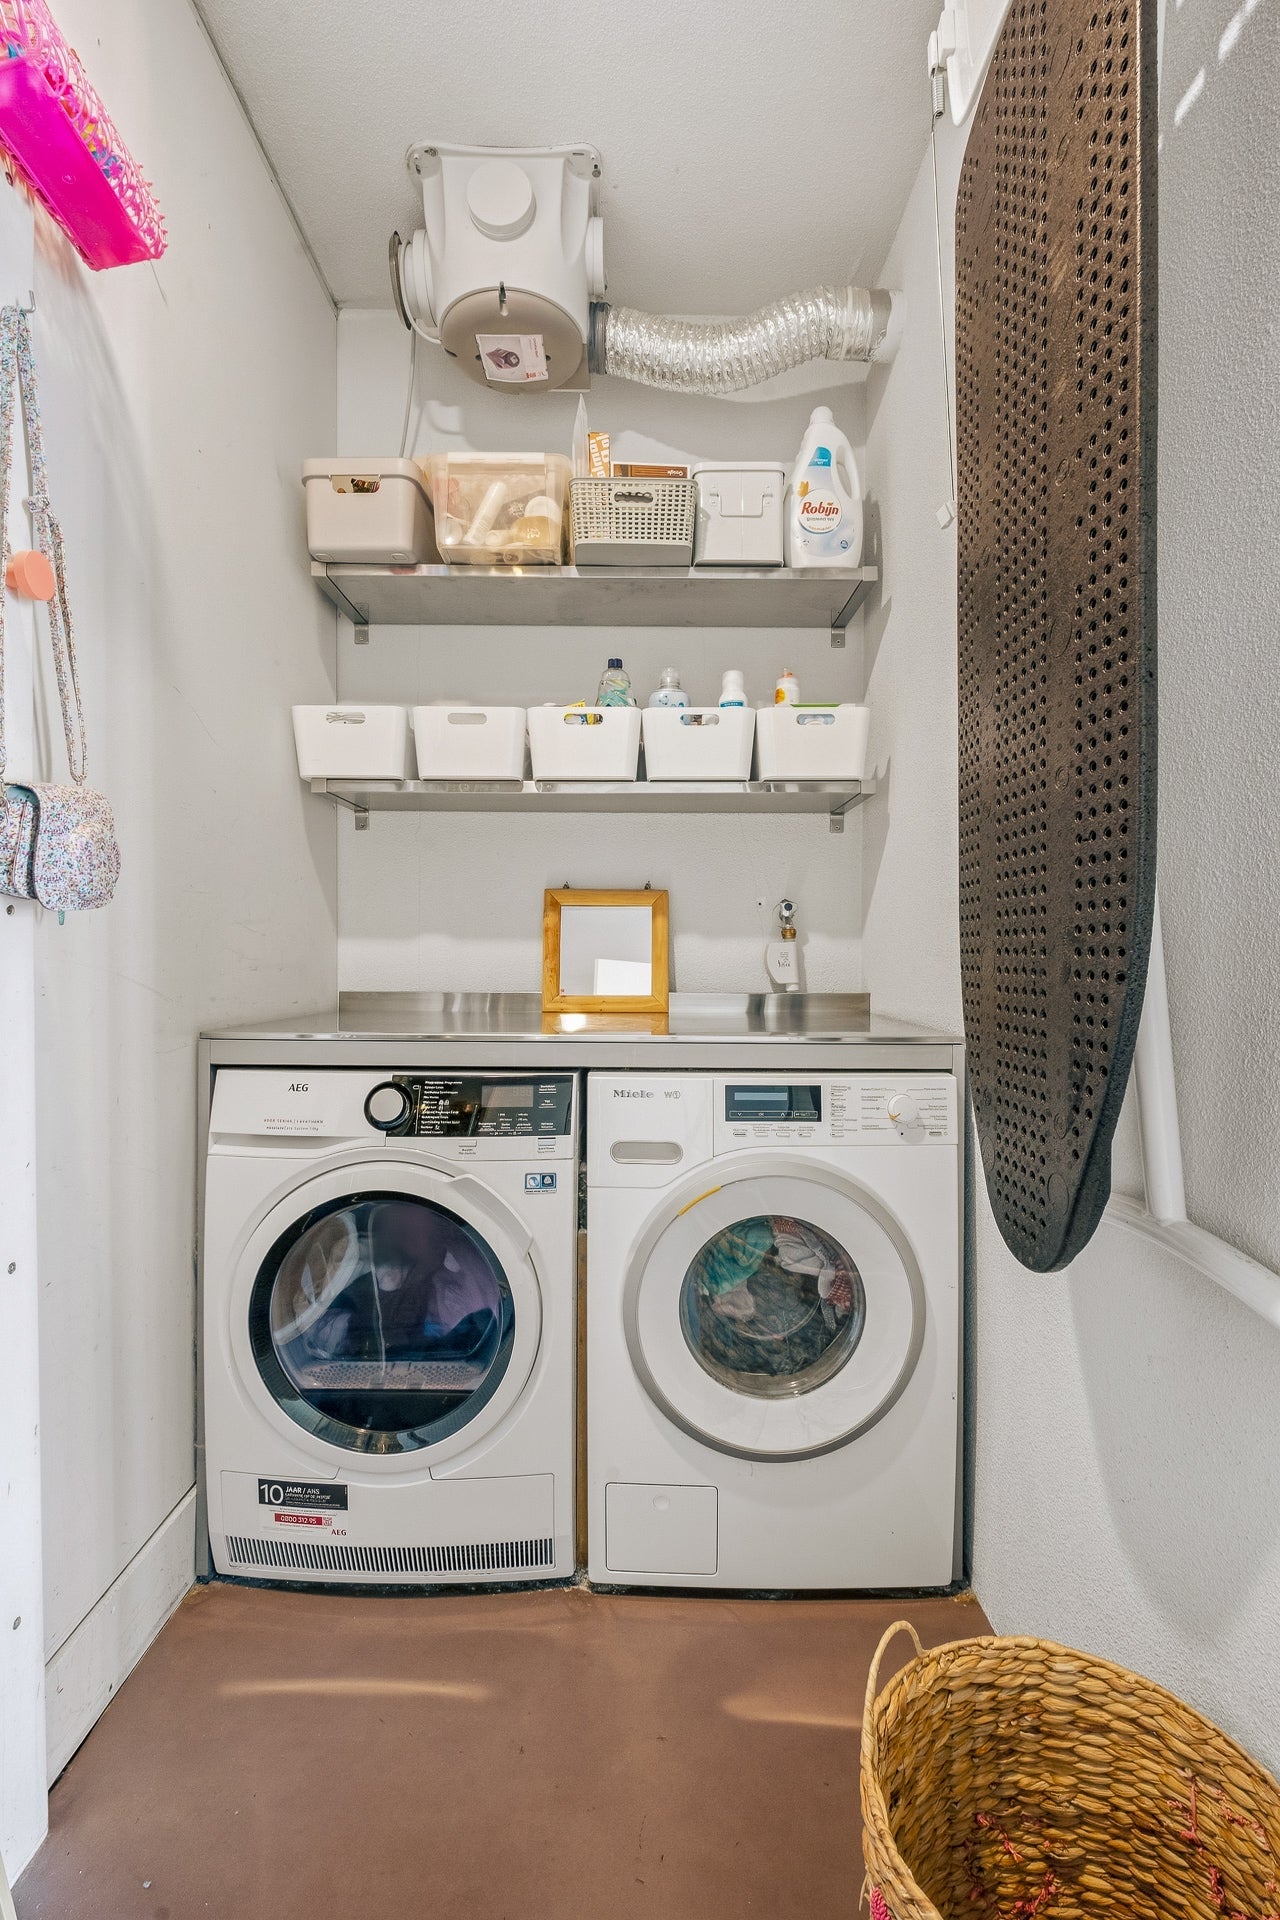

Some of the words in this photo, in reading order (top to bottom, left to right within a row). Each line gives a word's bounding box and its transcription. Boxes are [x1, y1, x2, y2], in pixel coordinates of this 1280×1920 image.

[801, 501, 840, 517] Robijn
[288, 1083, 309, 1092] AEG
[613, 1089, 655, 1099] Miele
[260, 1483, 284, 1504] 10
[285, 1486, 302, 1494] JAAR
[280, 1515, 297, 1523] 0800
[297, 1516, 308, 1524] 312
[331, 1528, 347, 1536] AEG
